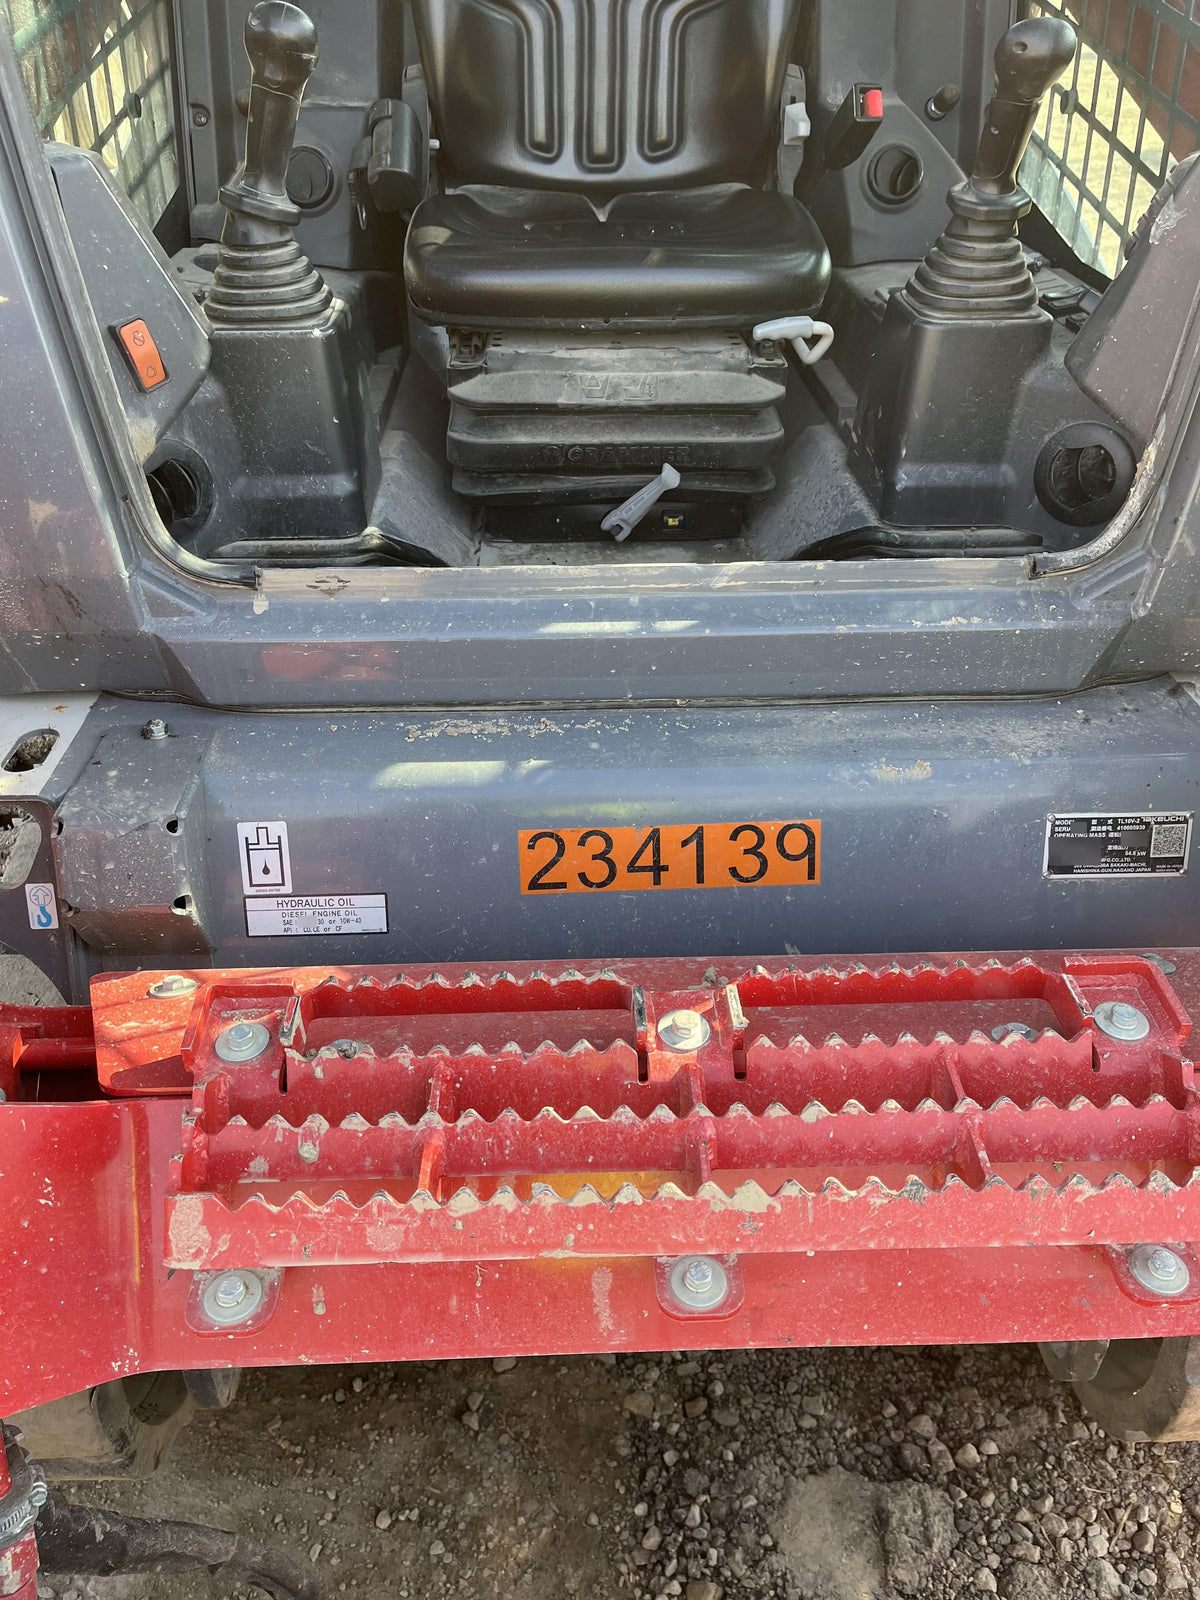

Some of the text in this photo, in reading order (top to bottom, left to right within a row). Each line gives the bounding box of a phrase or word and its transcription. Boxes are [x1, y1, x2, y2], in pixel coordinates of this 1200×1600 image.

[527, 822, 816, 891] 234139
[276, 898, 355, 908] HYDRAULIC OIL
